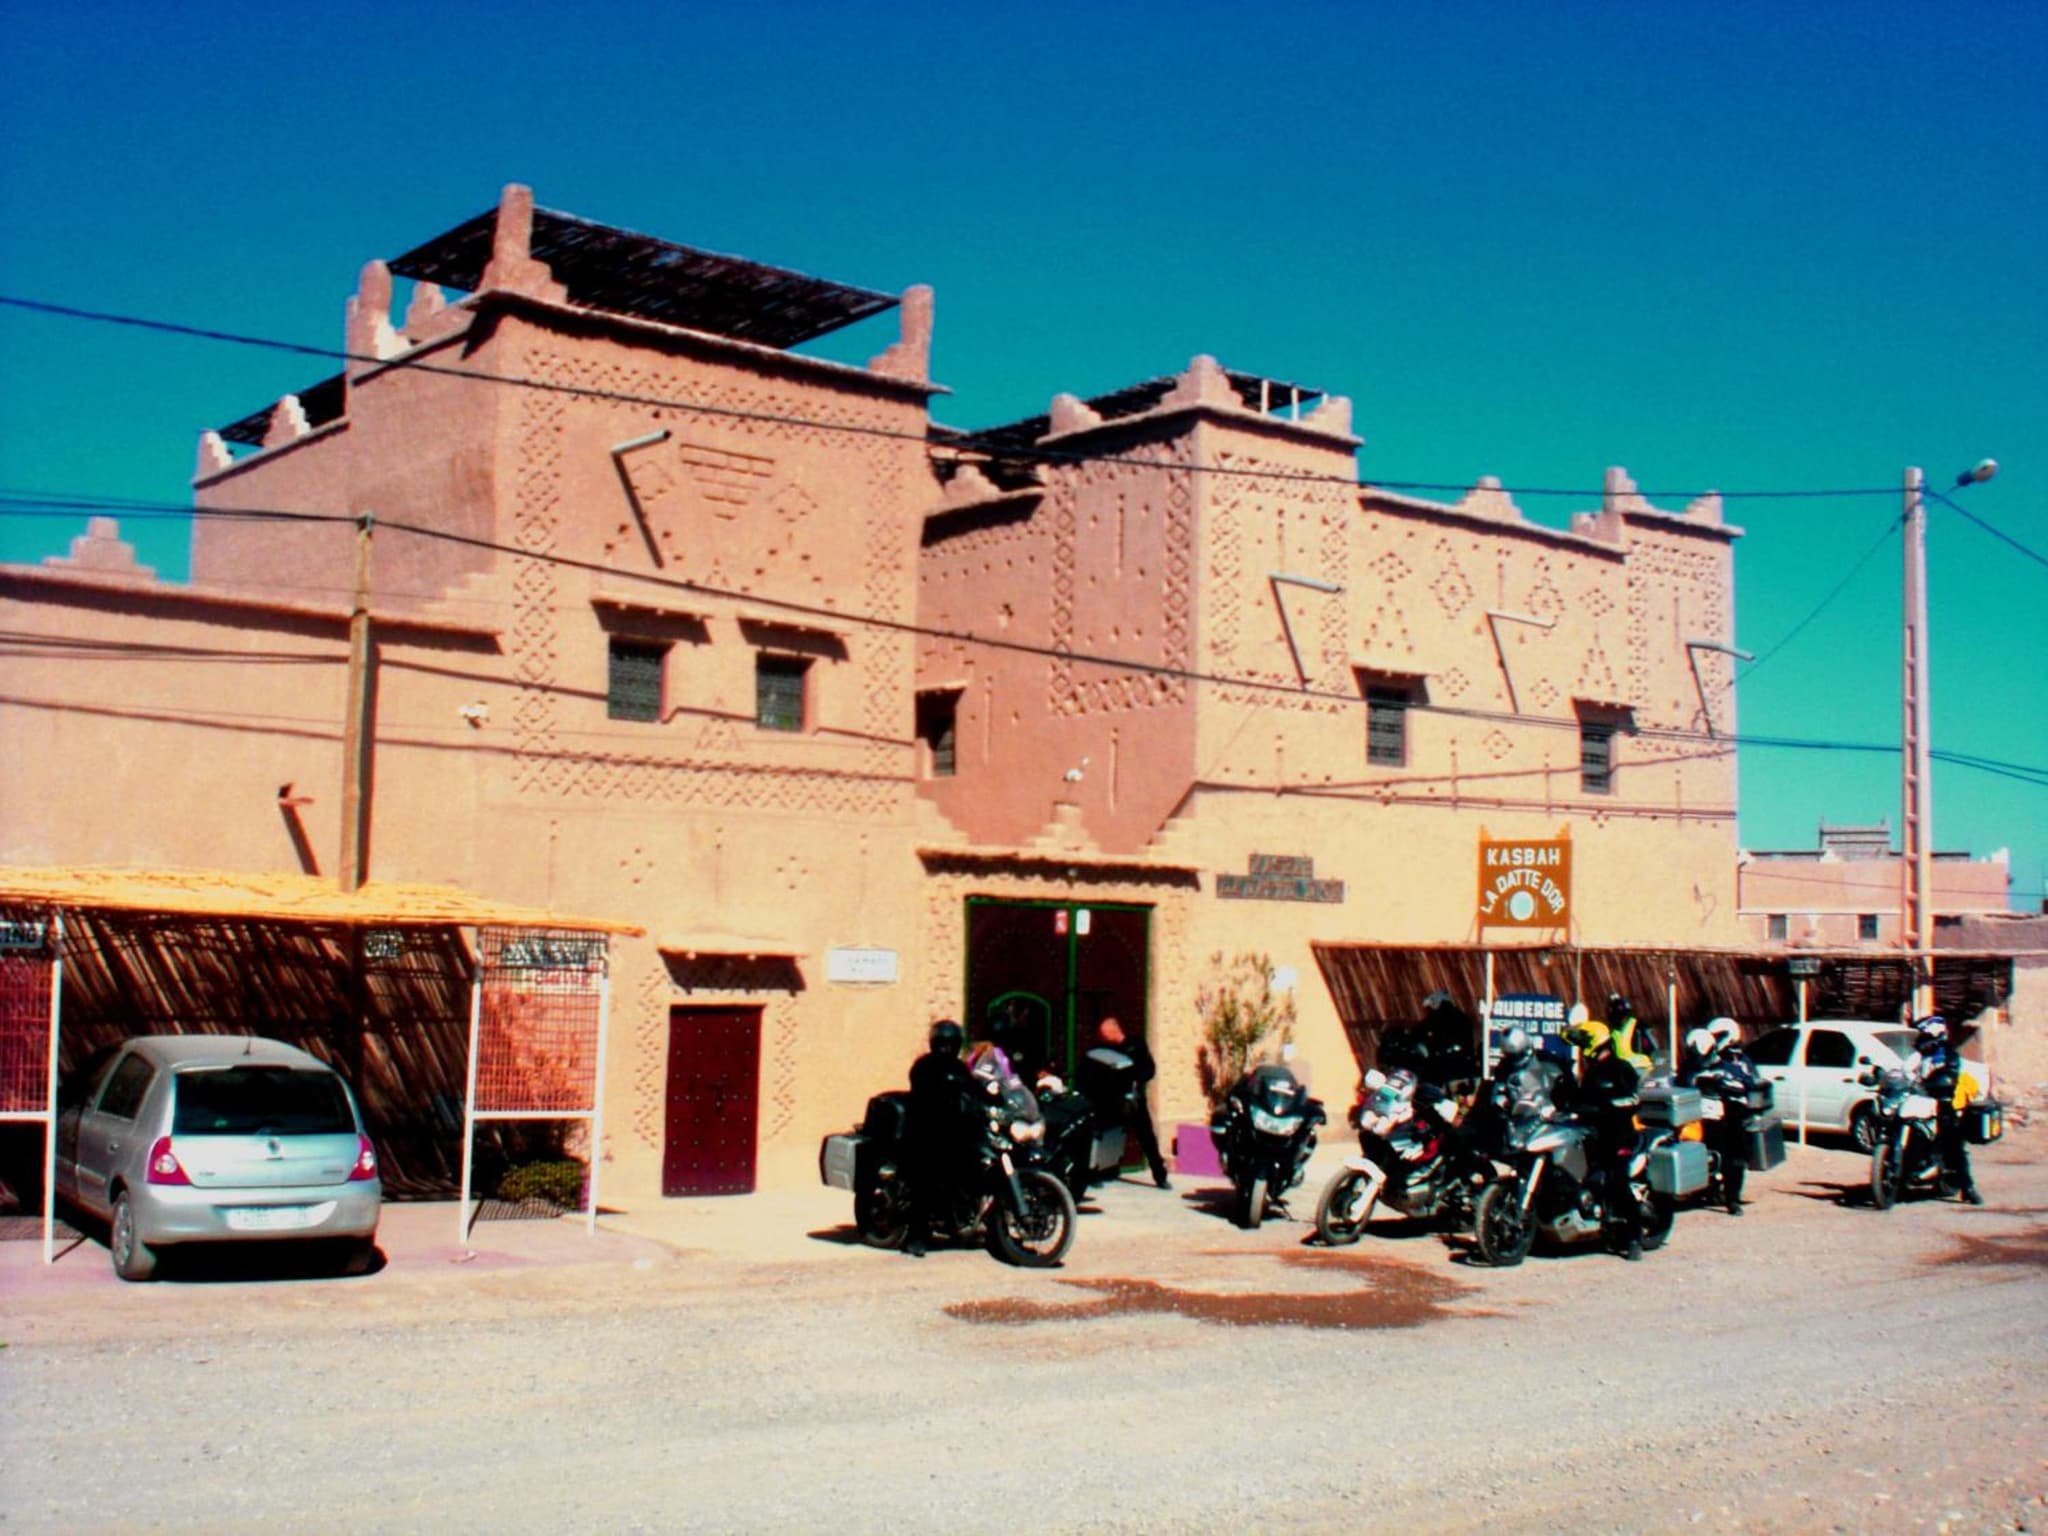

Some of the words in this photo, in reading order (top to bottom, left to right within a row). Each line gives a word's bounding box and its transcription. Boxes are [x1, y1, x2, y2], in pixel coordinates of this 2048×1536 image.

[1486, 848, 1560, 865] KASBAH
[1480, 889, 1499, 914] LA
[1496, 868, 1541, 893] DATTE
[1493, 1000, 1564, 1018] AUBERGE
